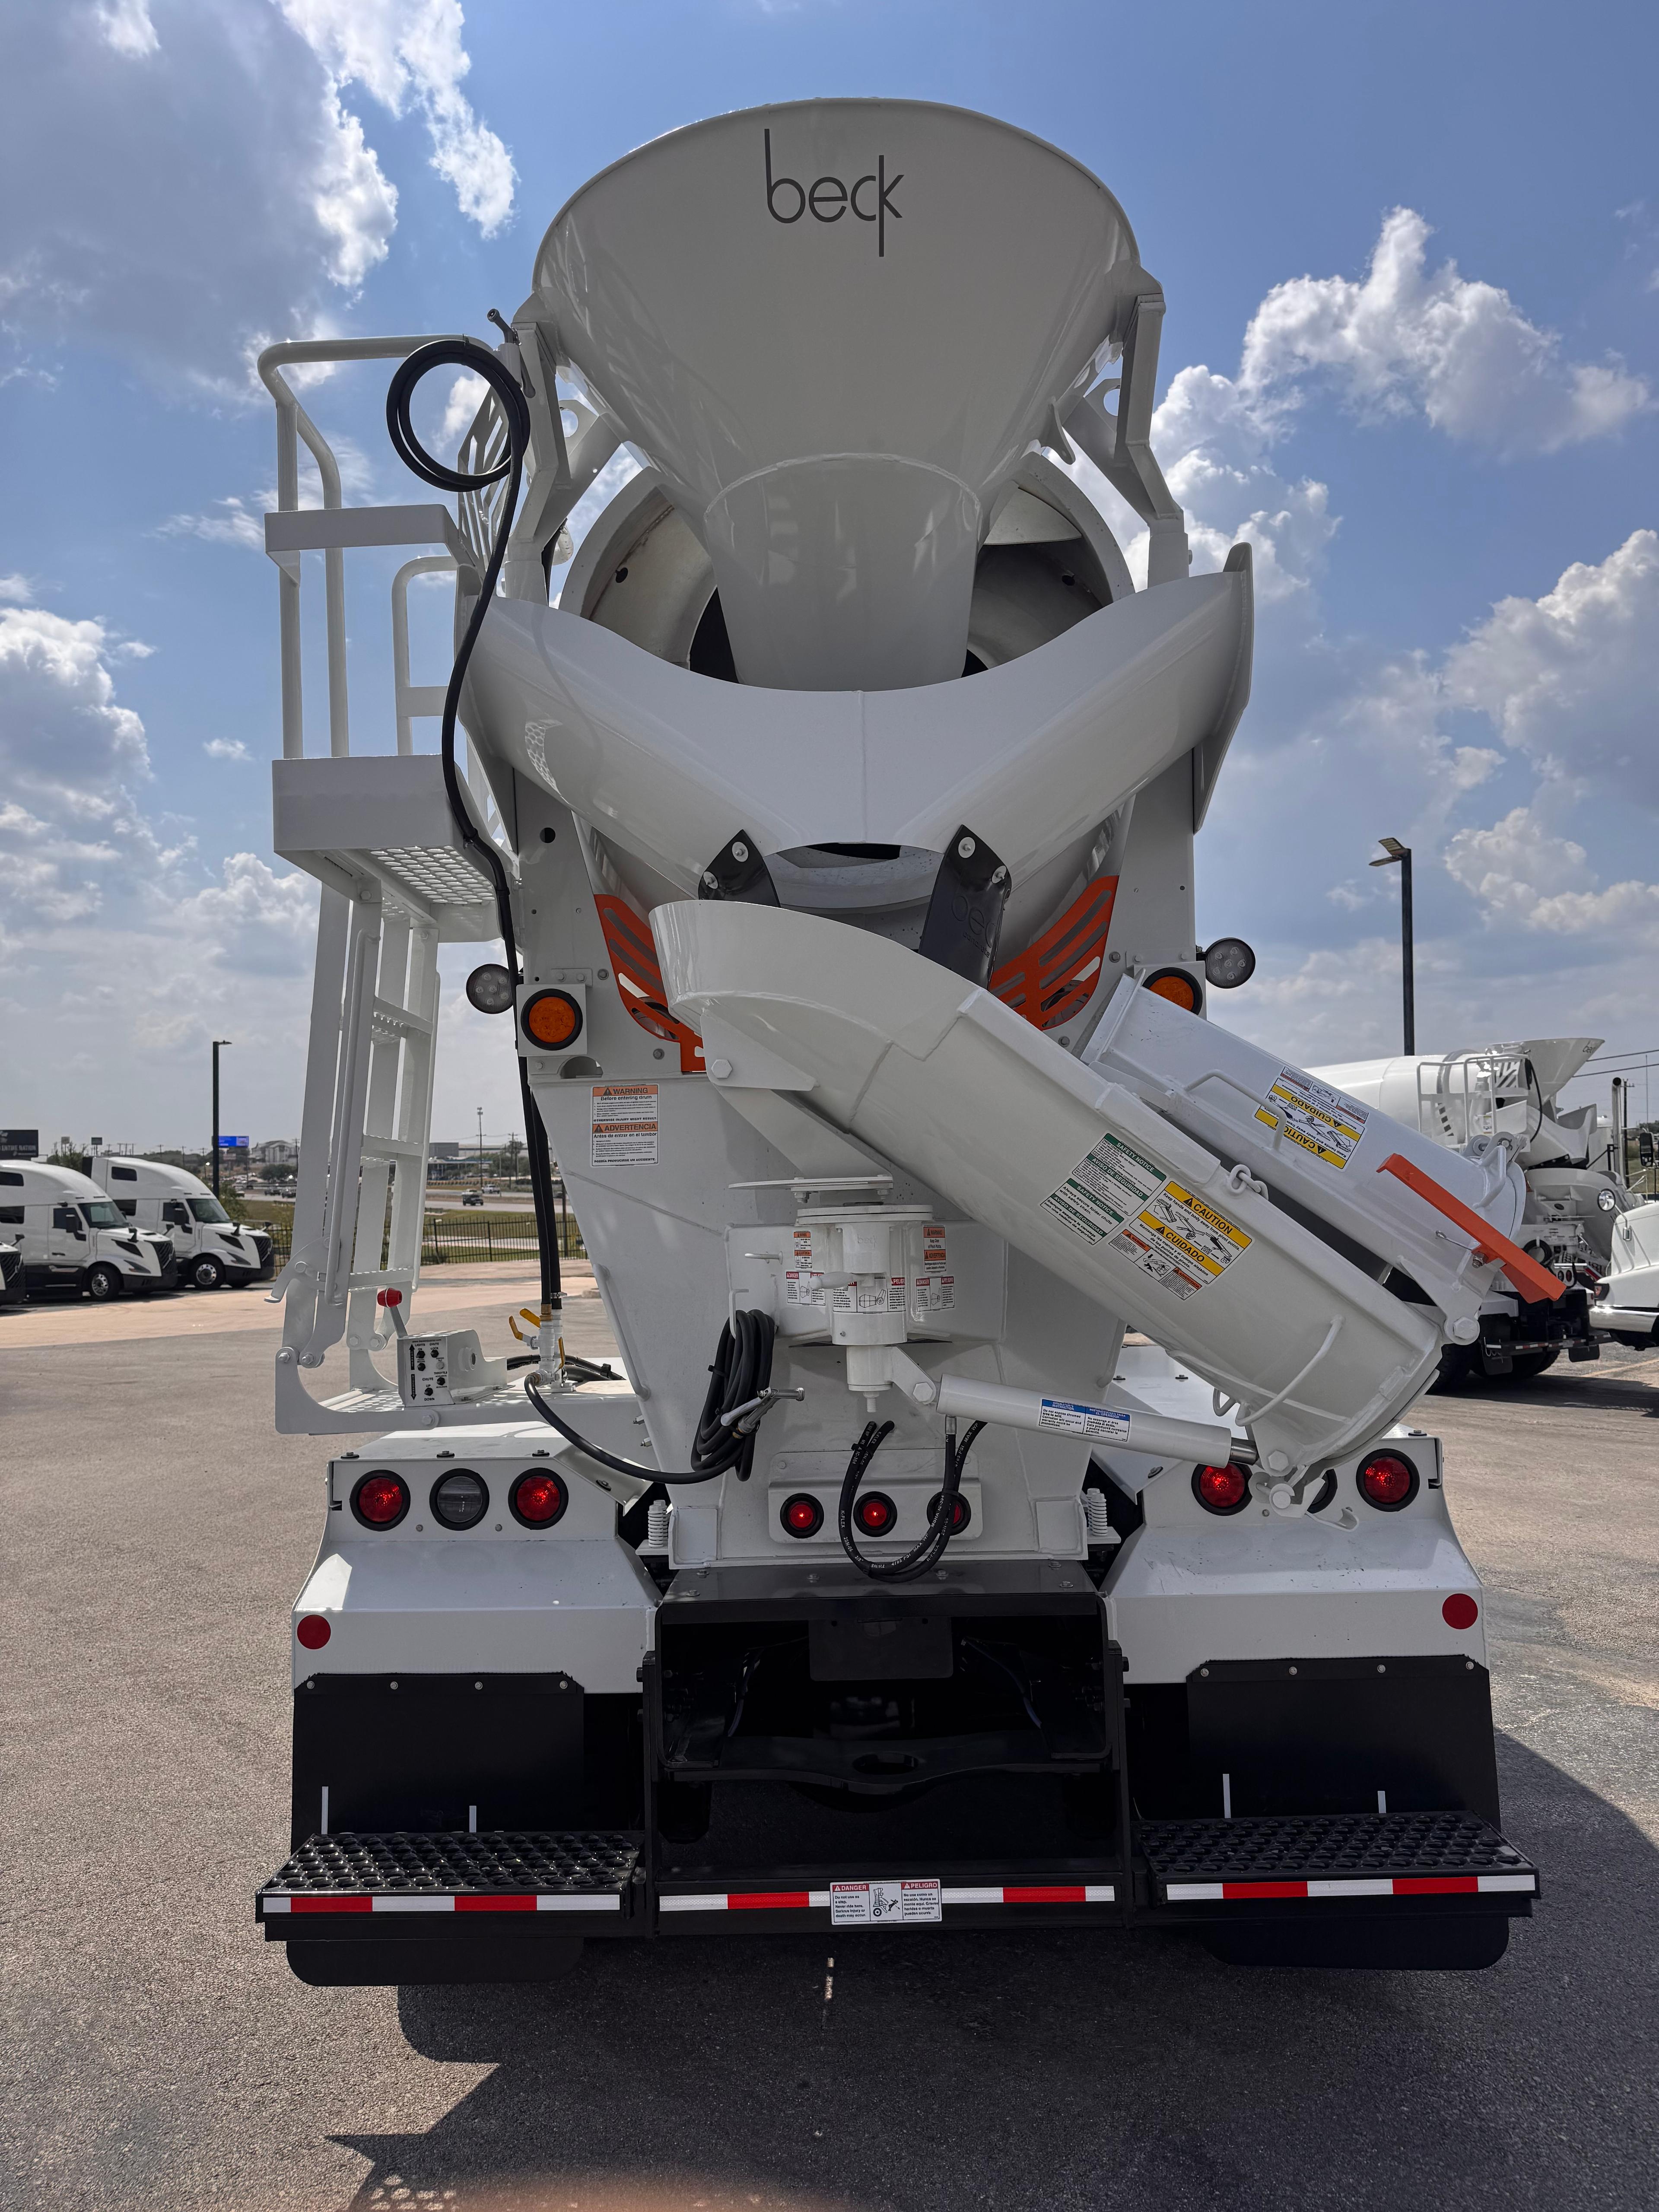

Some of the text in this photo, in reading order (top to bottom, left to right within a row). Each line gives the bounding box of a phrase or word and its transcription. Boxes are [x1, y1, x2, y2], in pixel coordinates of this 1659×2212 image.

[764, 128, 905, 257] beck
[1290, 1096, 1331, 1123] CUIDADO
[604, 1122, 656, 1132] ADVERTENCIA
[1274, 1120, 1316, 1149] CAUTIO
[1116, 1142, 1155, 1173] SAFETY NOTICE
[1091, 1157, 1144, 1197] AVISO DE SEGURIDAD
[1053, 1195, 1068, 1208] AVISO
[1075, 1212, 1103, 1235] SEGURIDAD
[1058, 1189, 1092, 1215] with safety chain.
[1062, 1185, 1113, 1225] Always secure folder chute
[1076, 1185, 1114, 1215] SAFETY NOTICE
[1162, 1192, 1173, 1201] Keep
[1172, 1199, 1185, 1210] hands
[1190, 1212, 1201, 1222] body
[1199, 1220, 1210, 1230] away
[1209, 1227, 1219, 1235] from
[1217, 1233, 1228, 1243] pivot
[1227, 1240, 1241, 1252] points.
[1192, 1202, 1233, 1235] CAUTION
[1164, 1230, 1205, 1263] CUIDADO
[963, 1431, 973, 1443] MAX
[971, 1422, 978, 1430] WP
[913, 1542, 922, 1552] MAX
